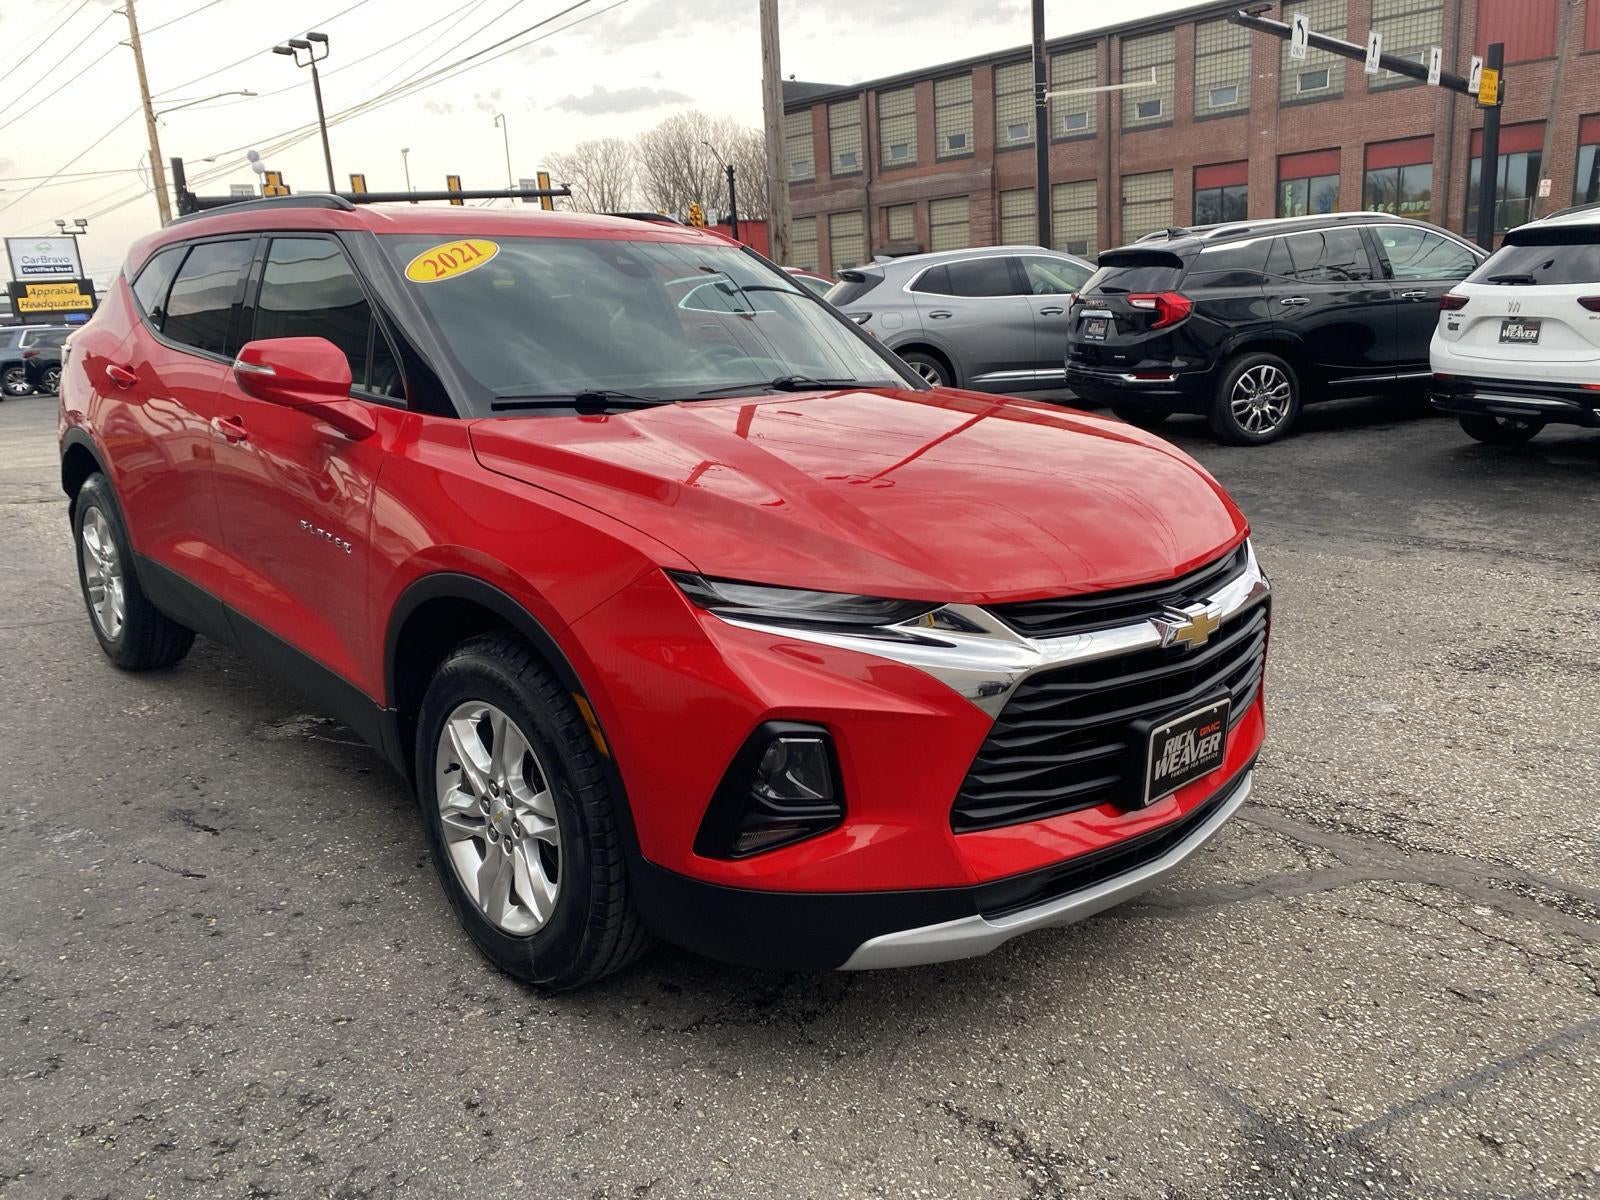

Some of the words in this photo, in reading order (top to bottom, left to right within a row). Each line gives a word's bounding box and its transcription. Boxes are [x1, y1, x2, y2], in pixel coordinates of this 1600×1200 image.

[21, 255, 70, 264] CarBravo
[422, 242, 483, 277] 2021
[28, 286, 77, 298] Appraisal
[21, 298, 89, 311] Headquarters
[1502, 329, 1537, 338] WEAVER
[299, 519, 352, 554] BLAZER
[1199, 720, 1221, 737] GMC
[1163, 727, 1197, 757] RICK
[1154, 731, 1222, 781] WEAVER
